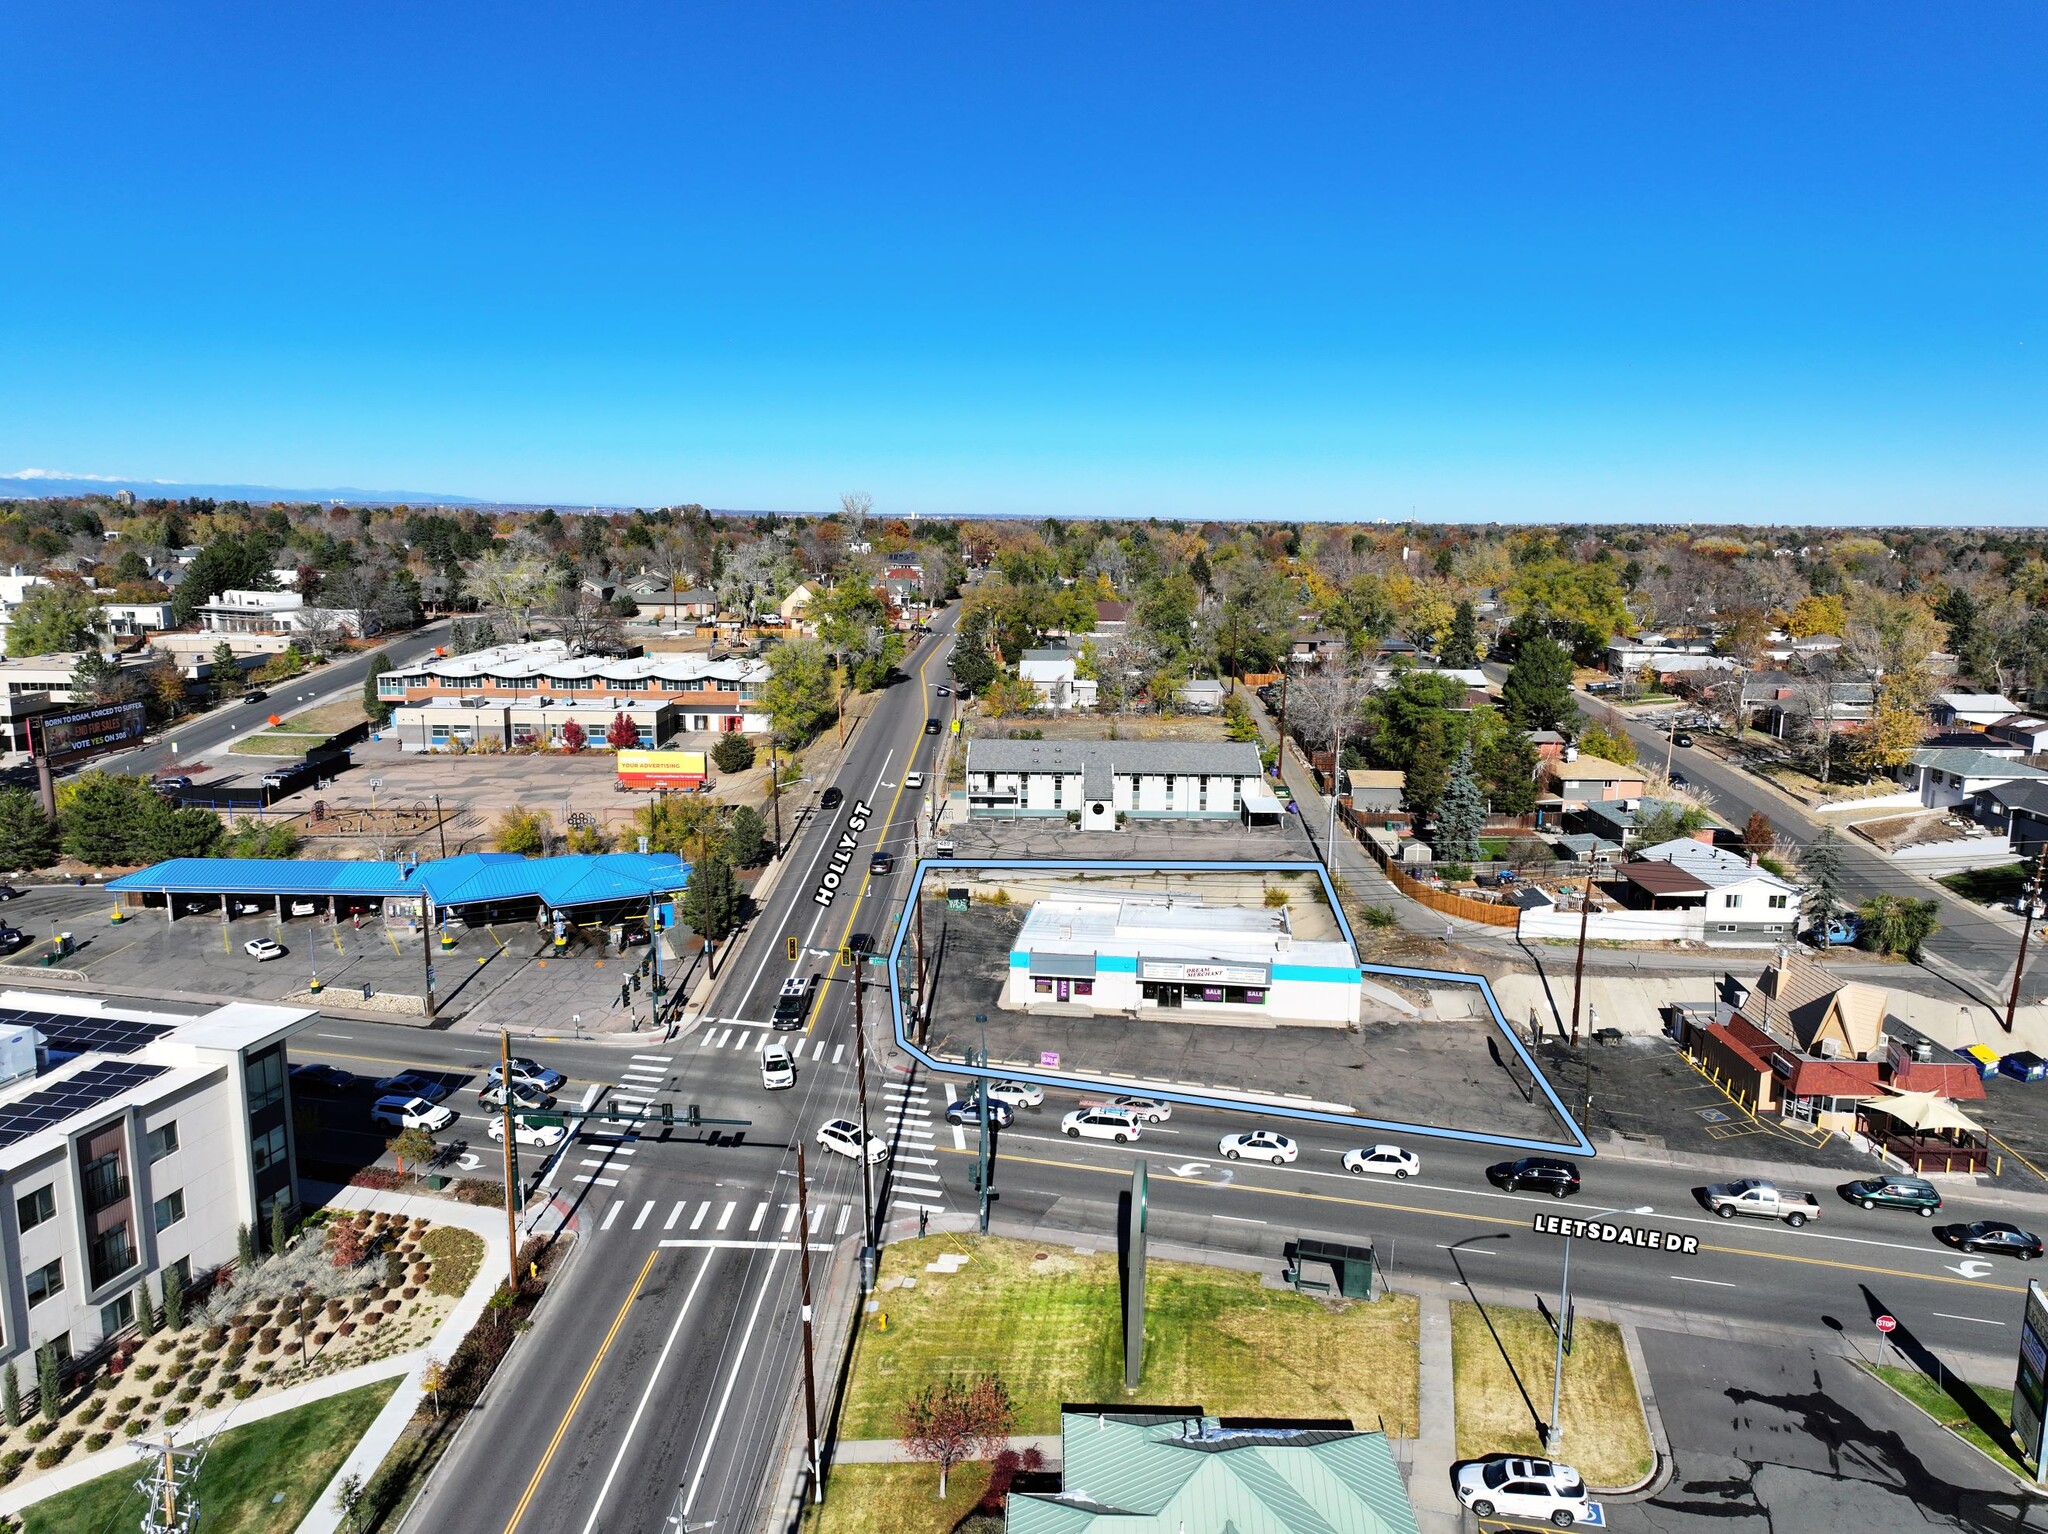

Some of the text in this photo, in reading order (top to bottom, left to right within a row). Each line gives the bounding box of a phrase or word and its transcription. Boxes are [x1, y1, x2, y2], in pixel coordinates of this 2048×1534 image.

[44, 719, 63, 728] BORN
[72, 712, 91, 722] ROAM,
[91, 708, 114, 718] FORCED
[114, 705, 122, 713] TO
[122, 701, 144, 712] SUFFER.
[75, 719, 120, 737] END FUR SALES
[71, 731, 127, 750] VOTE YES ON 308
[1042, 1056, 1058, 1064] SALE
[1878, 1319, 1894, 1327] STOP
